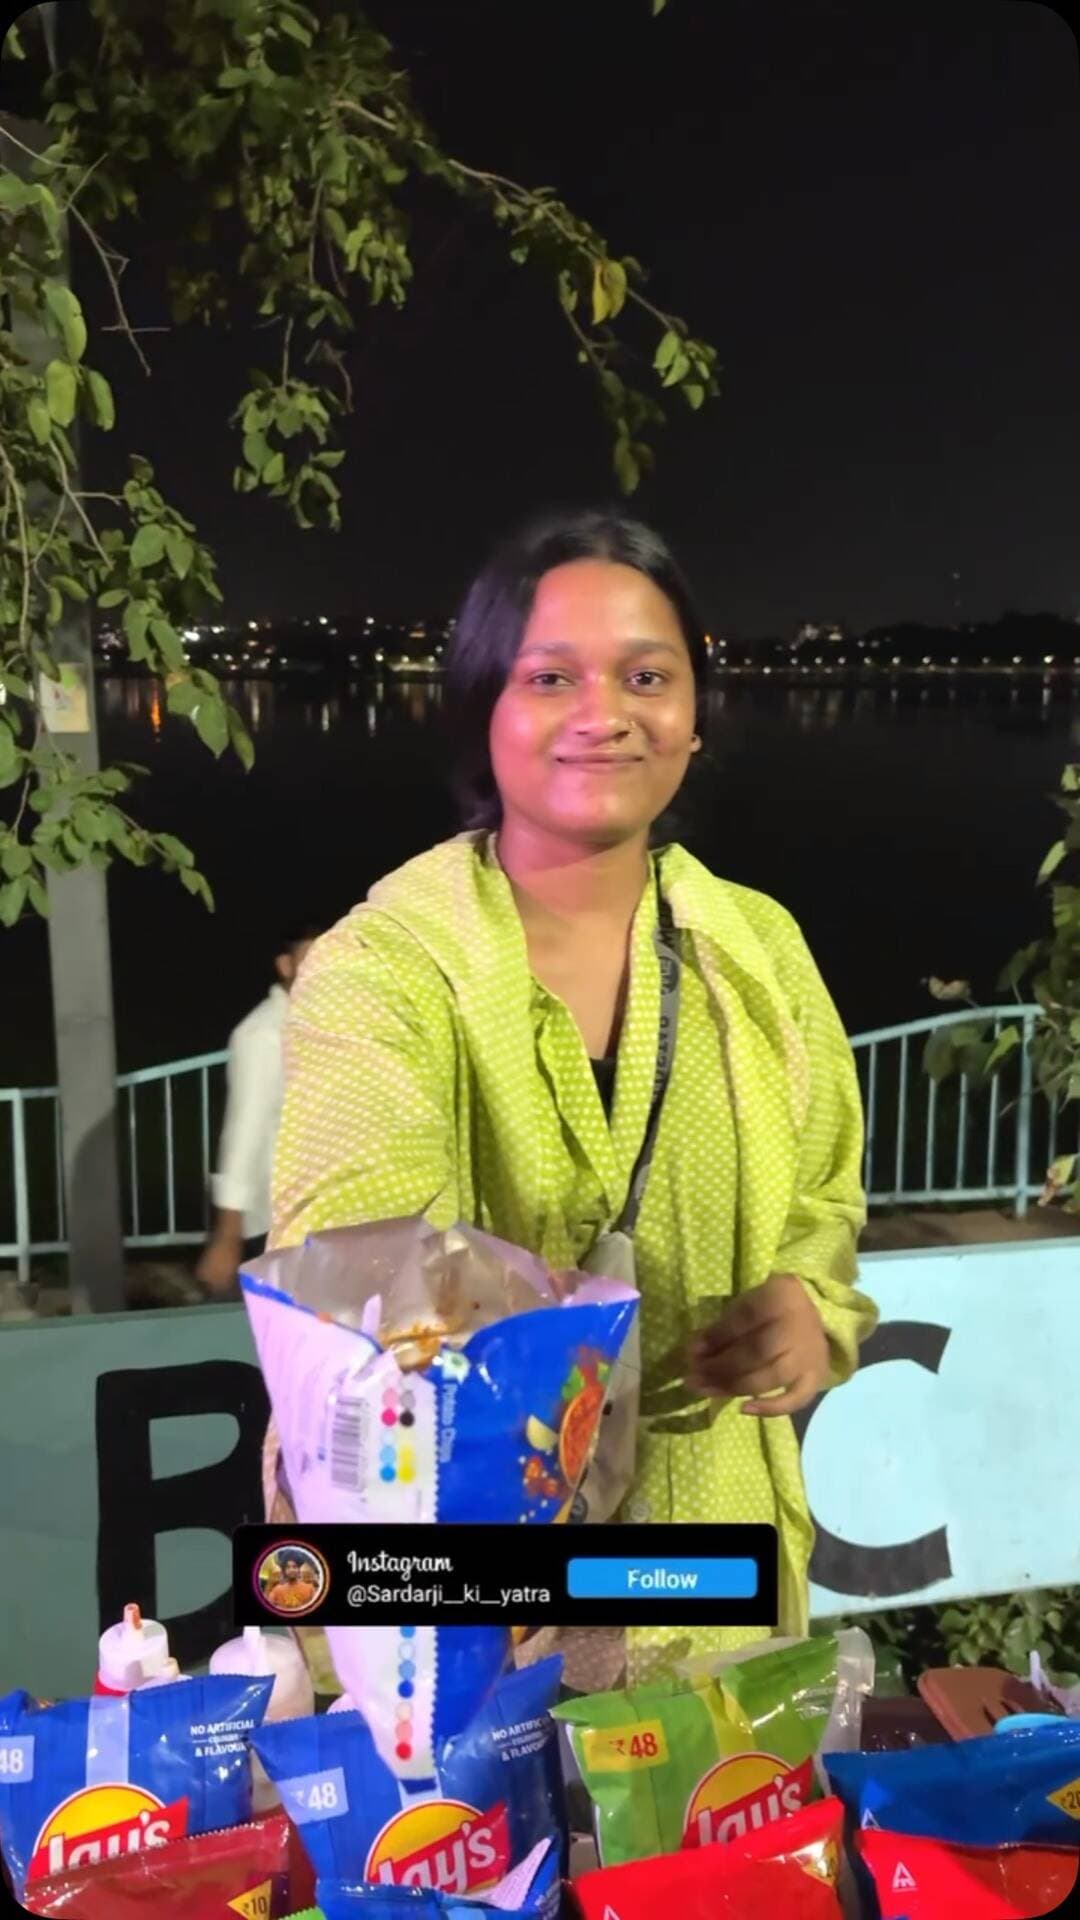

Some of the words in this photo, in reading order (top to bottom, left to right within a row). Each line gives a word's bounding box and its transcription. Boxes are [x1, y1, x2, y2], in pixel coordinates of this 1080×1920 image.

[95, 1359, 272, 1670] B
[190, 1724, 206, 1736] NO
[207, 1718, 255, 1734] ARTIFICIAL
[492, 1728, 508, 1741] NO
